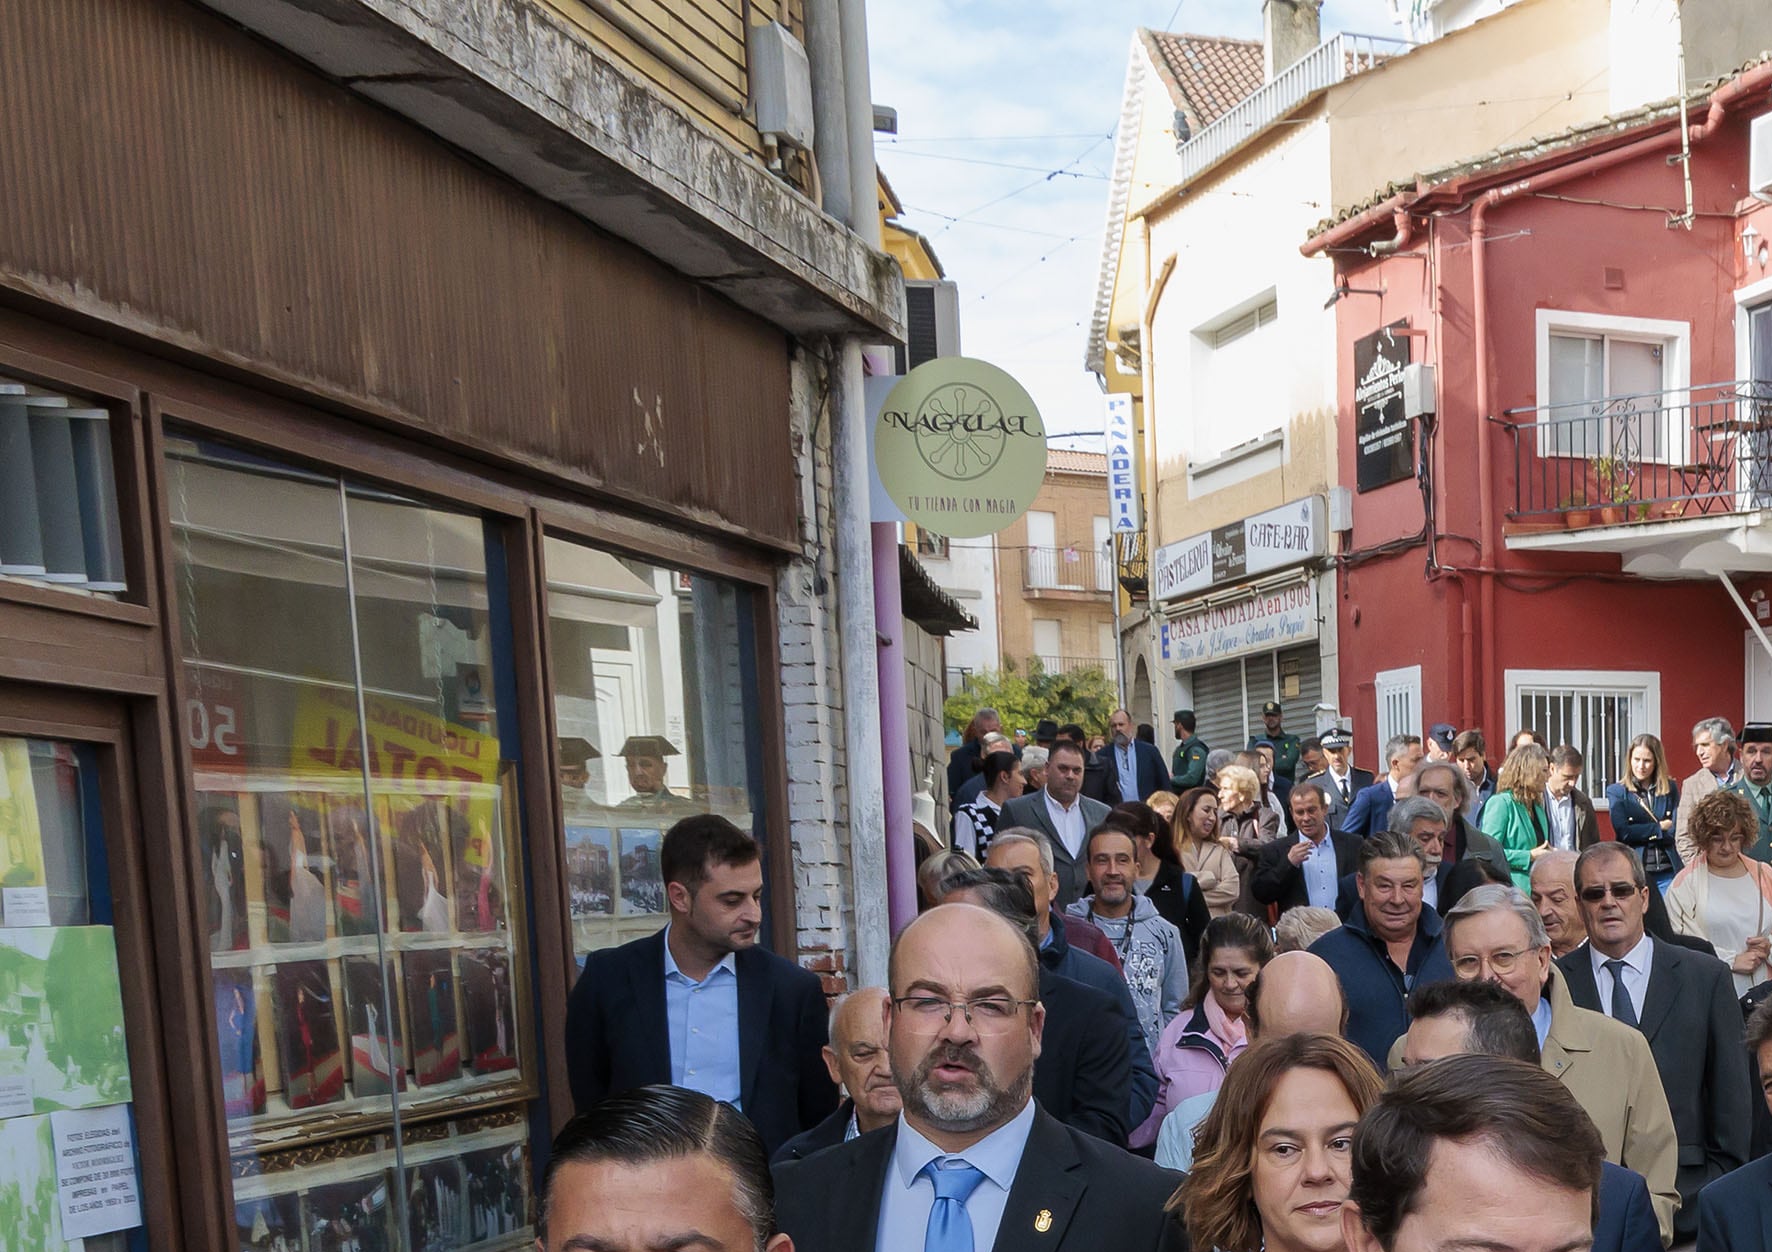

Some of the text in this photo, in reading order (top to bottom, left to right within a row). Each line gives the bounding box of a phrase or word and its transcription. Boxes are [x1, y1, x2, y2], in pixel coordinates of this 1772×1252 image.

[883, 411, 1042, 437] NAGUAL
[908, 495, 1017, 514] TU TIENDA CON MAGIA
[1169, 583, 1311, 641] CASA FUNDADA en 1909
